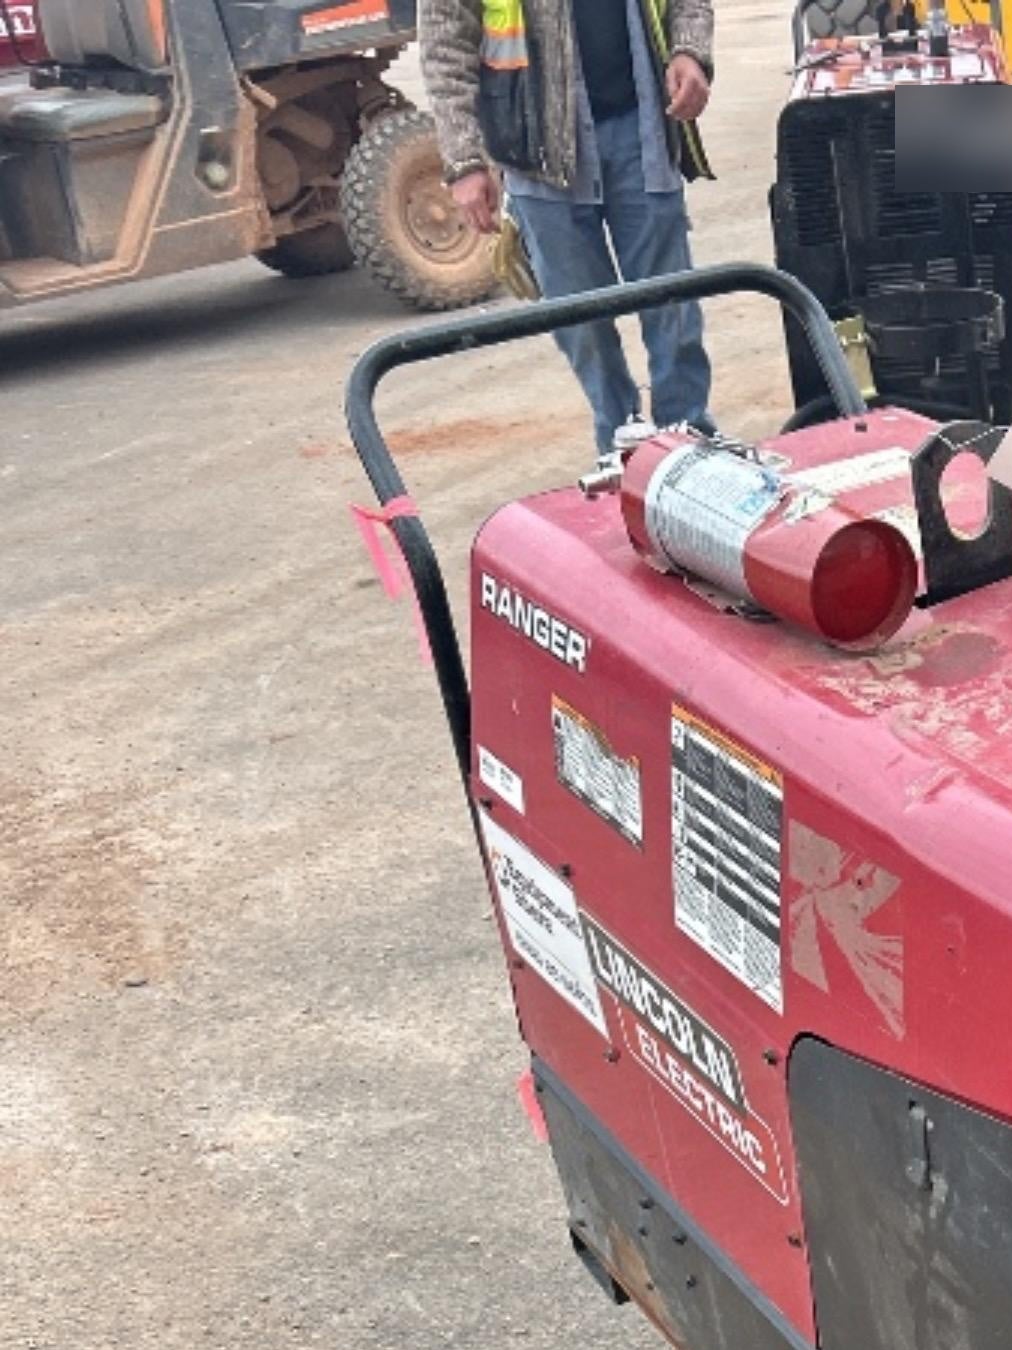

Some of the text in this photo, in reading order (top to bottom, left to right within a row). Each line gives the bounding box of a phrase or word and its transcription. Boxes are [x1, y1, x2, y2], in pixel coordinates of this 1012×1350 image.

[480, 572, 587, 672] RANGER
[587, 926, 739, 1106] LINCOLN
[635, 1023, 766, 1174] ELECTRIC
